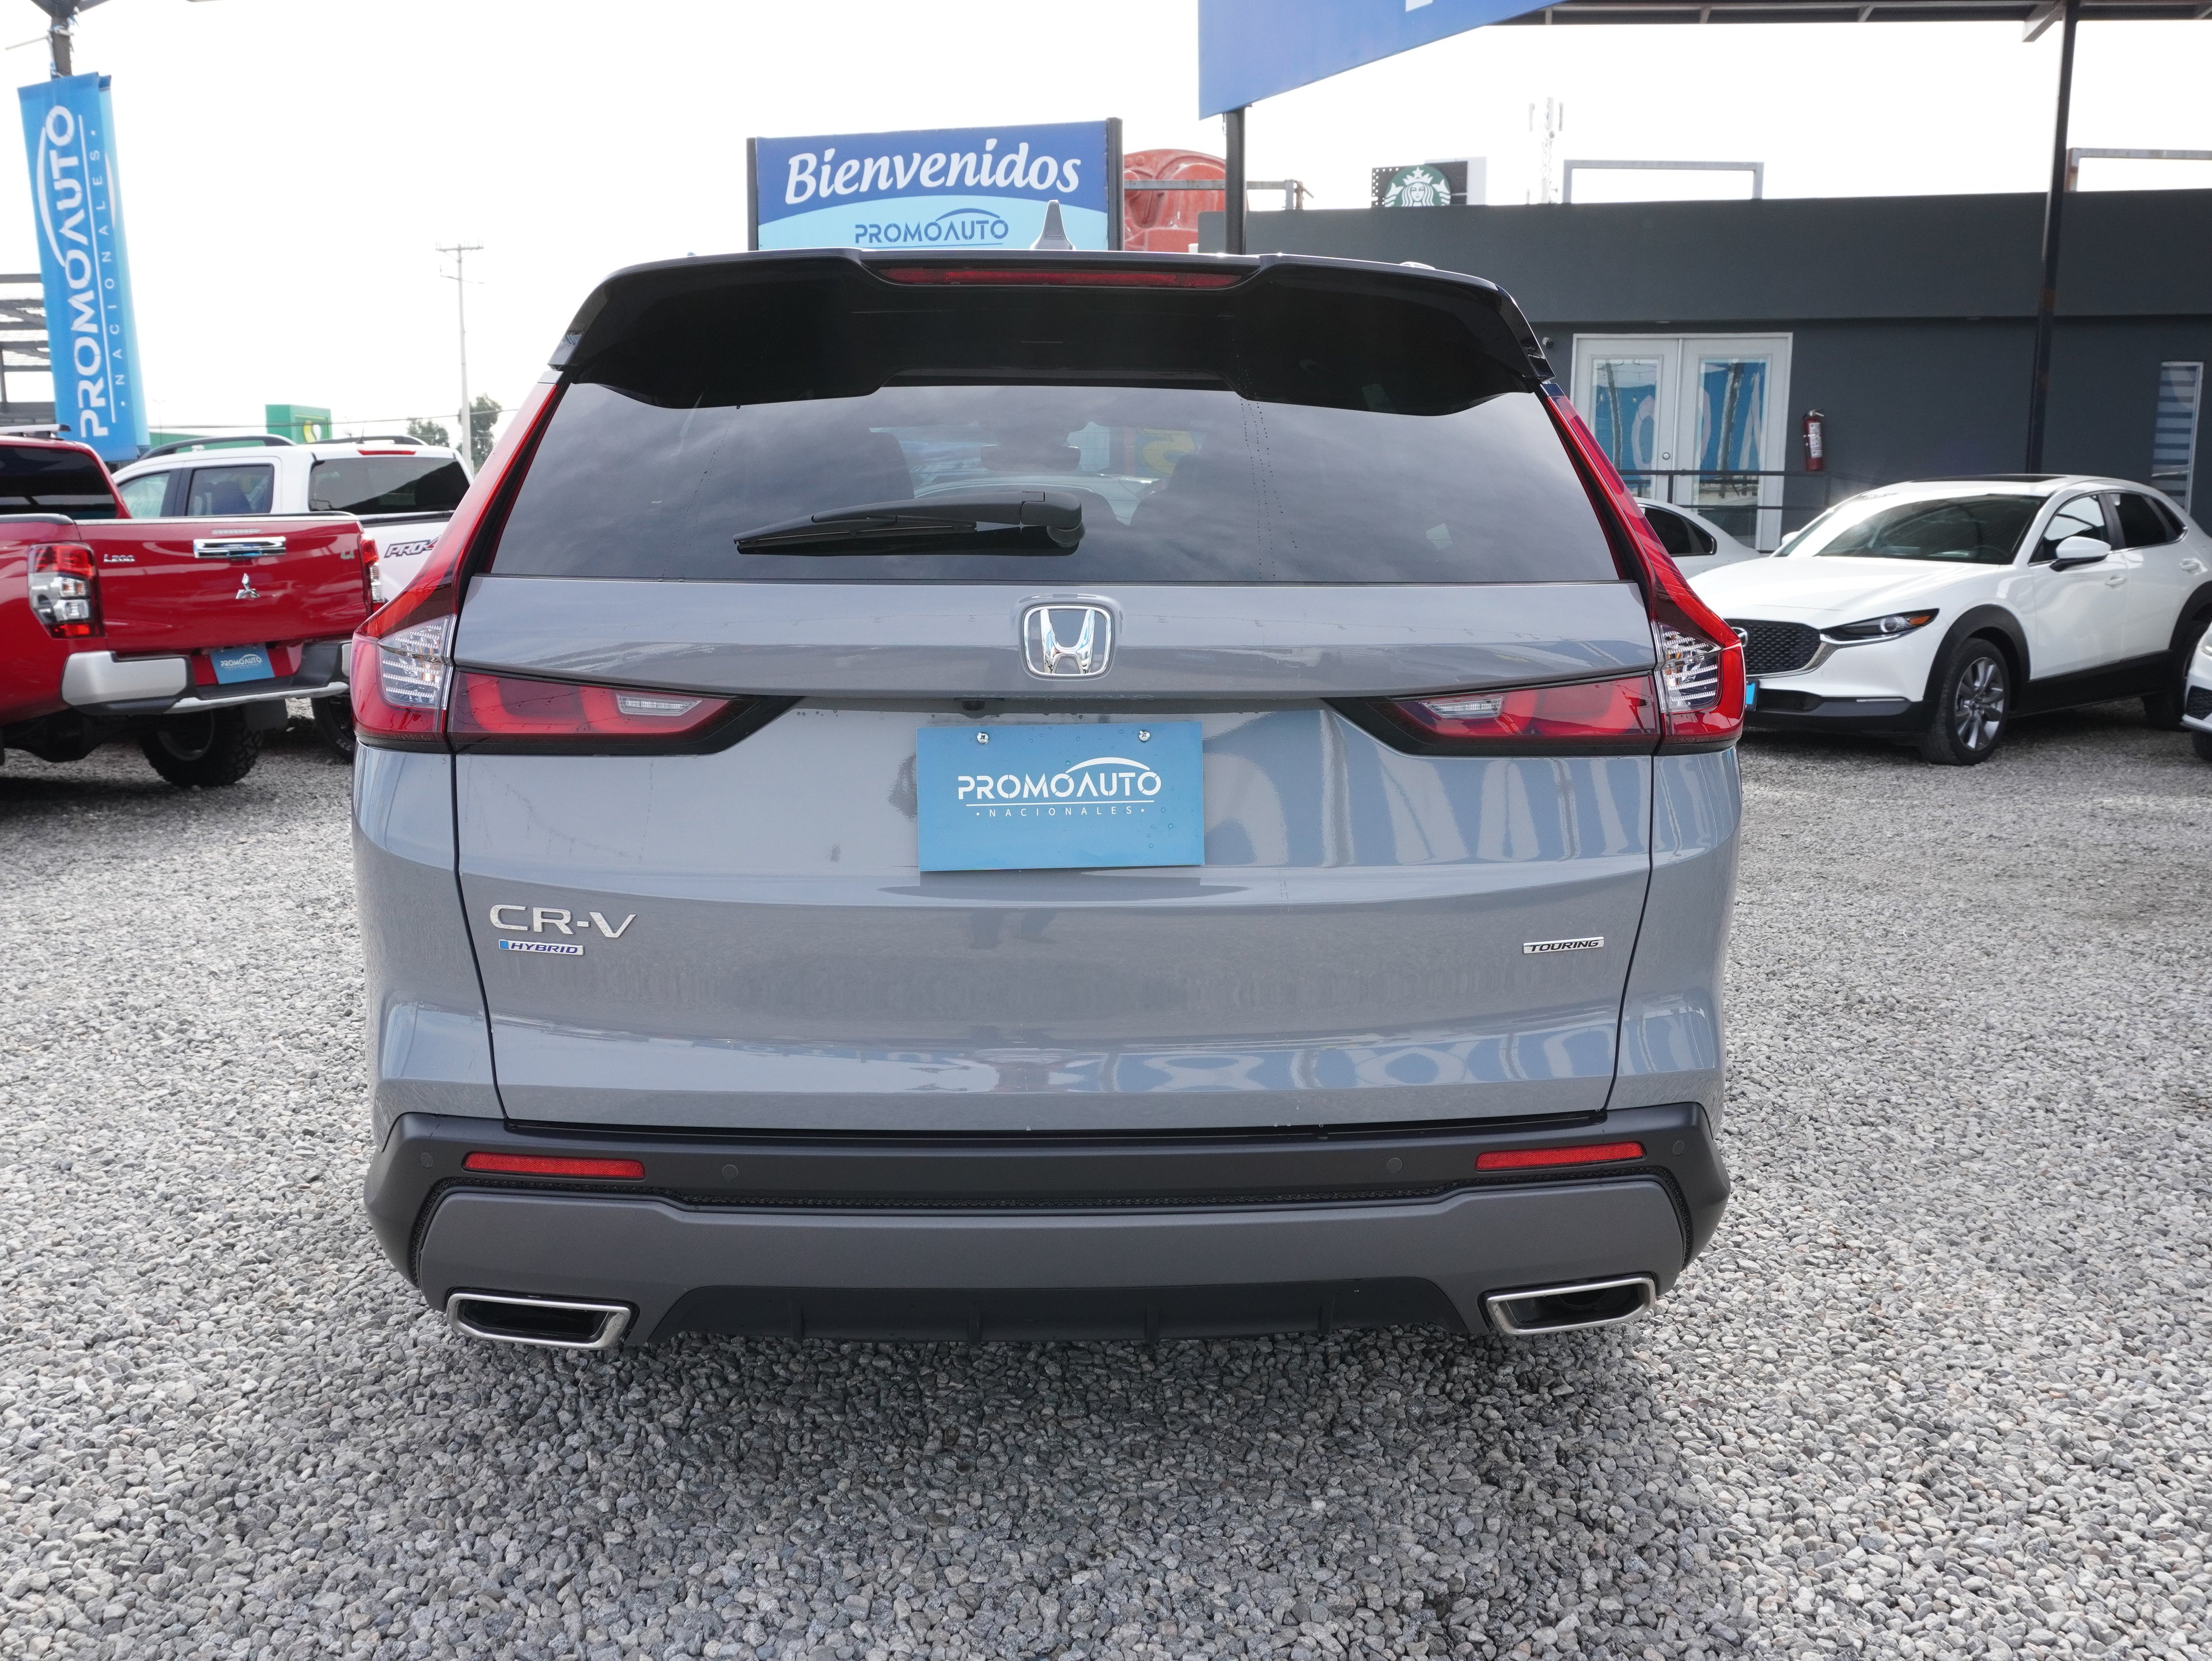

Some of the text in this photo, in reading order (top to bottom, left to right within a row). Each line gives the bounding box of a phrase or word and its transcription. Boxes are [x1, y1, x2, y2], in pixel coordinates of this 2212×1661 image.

[785, 138, 1081, 205] Bienvenidos
[855, 220, 1009, 243] PROMOAUTO
[44, 105, 108, 438] PROMOAUTO
[90, 150, 125, 385] NACIONALES
[220, 657, 262, 667] PROMOAUTO
[958, 771, 1161, 800] PROMOAUTO
[989, 805, 1132, 817] NACIONALES
[490, 904, 637, 938] CR-V
[511, 942, 578, 954] HYBRID
[1530, 940, 1600, 952] TOURING
